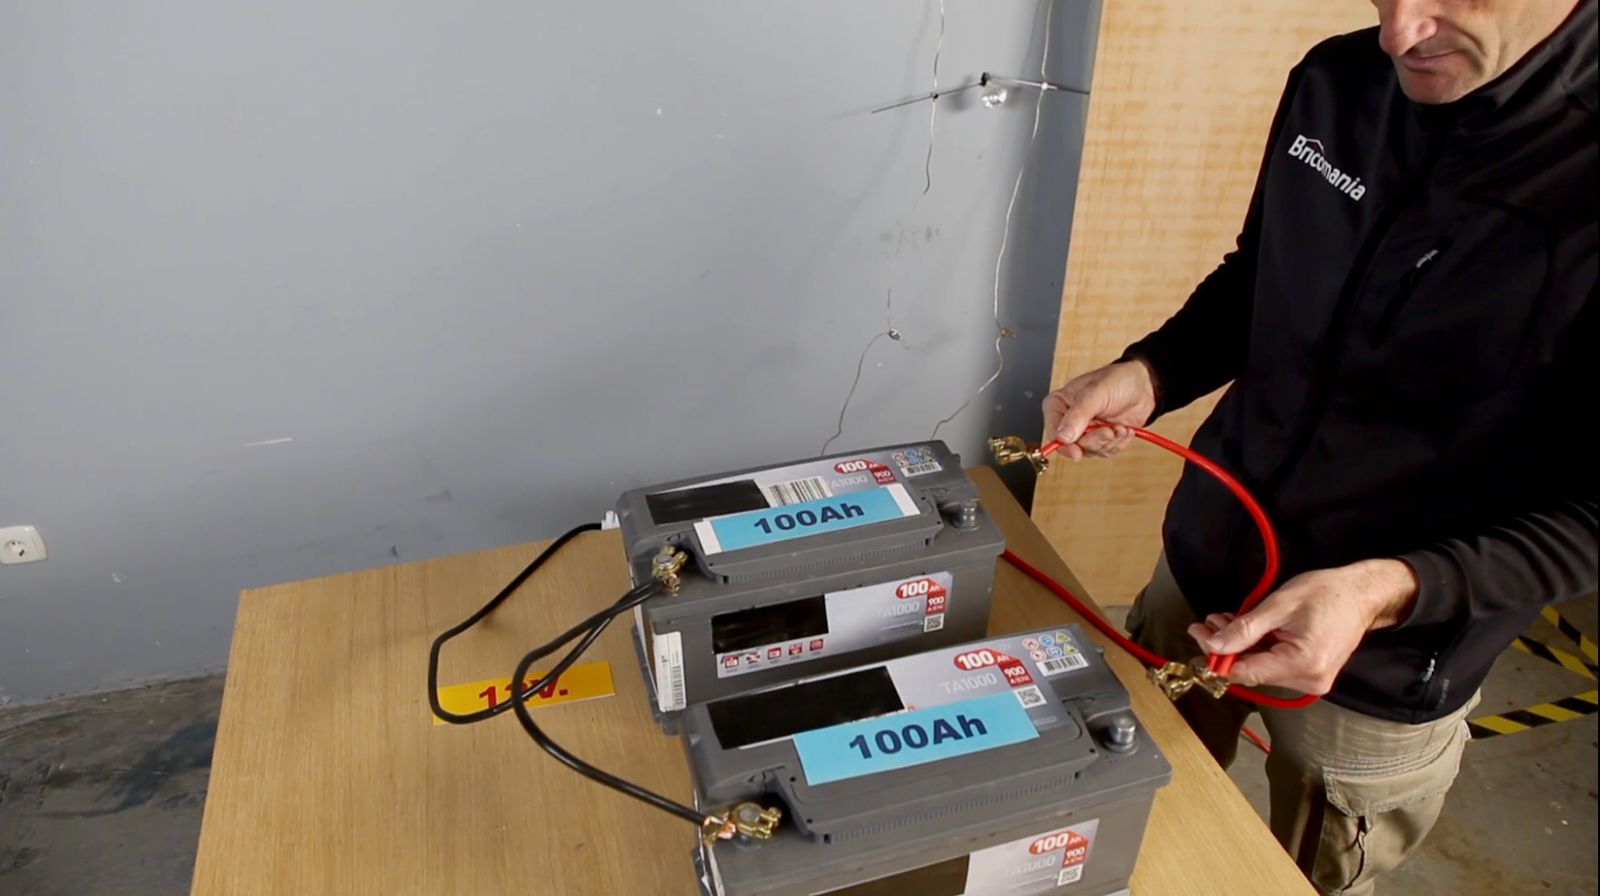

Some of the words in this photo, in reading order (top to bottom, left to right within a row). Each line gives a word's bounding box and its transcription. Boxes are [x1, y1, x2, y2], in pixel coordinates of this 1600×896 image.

[1288, 134, 1366, 201] Bricomania
[837, 459, 868, 473] 100
[754, 502, 864, 534] 100Ah
[899, 580, 929, 597] 100
[957, 650, 995, 669] 100
[1004, 665, 1026, 678] 900
[943, 672, 997, 694] TA1000
[849, 714, 988, 759] 100Ah
[1034, 832, 1069, 853] 100
[1066, 847, 1086, 858] 900
